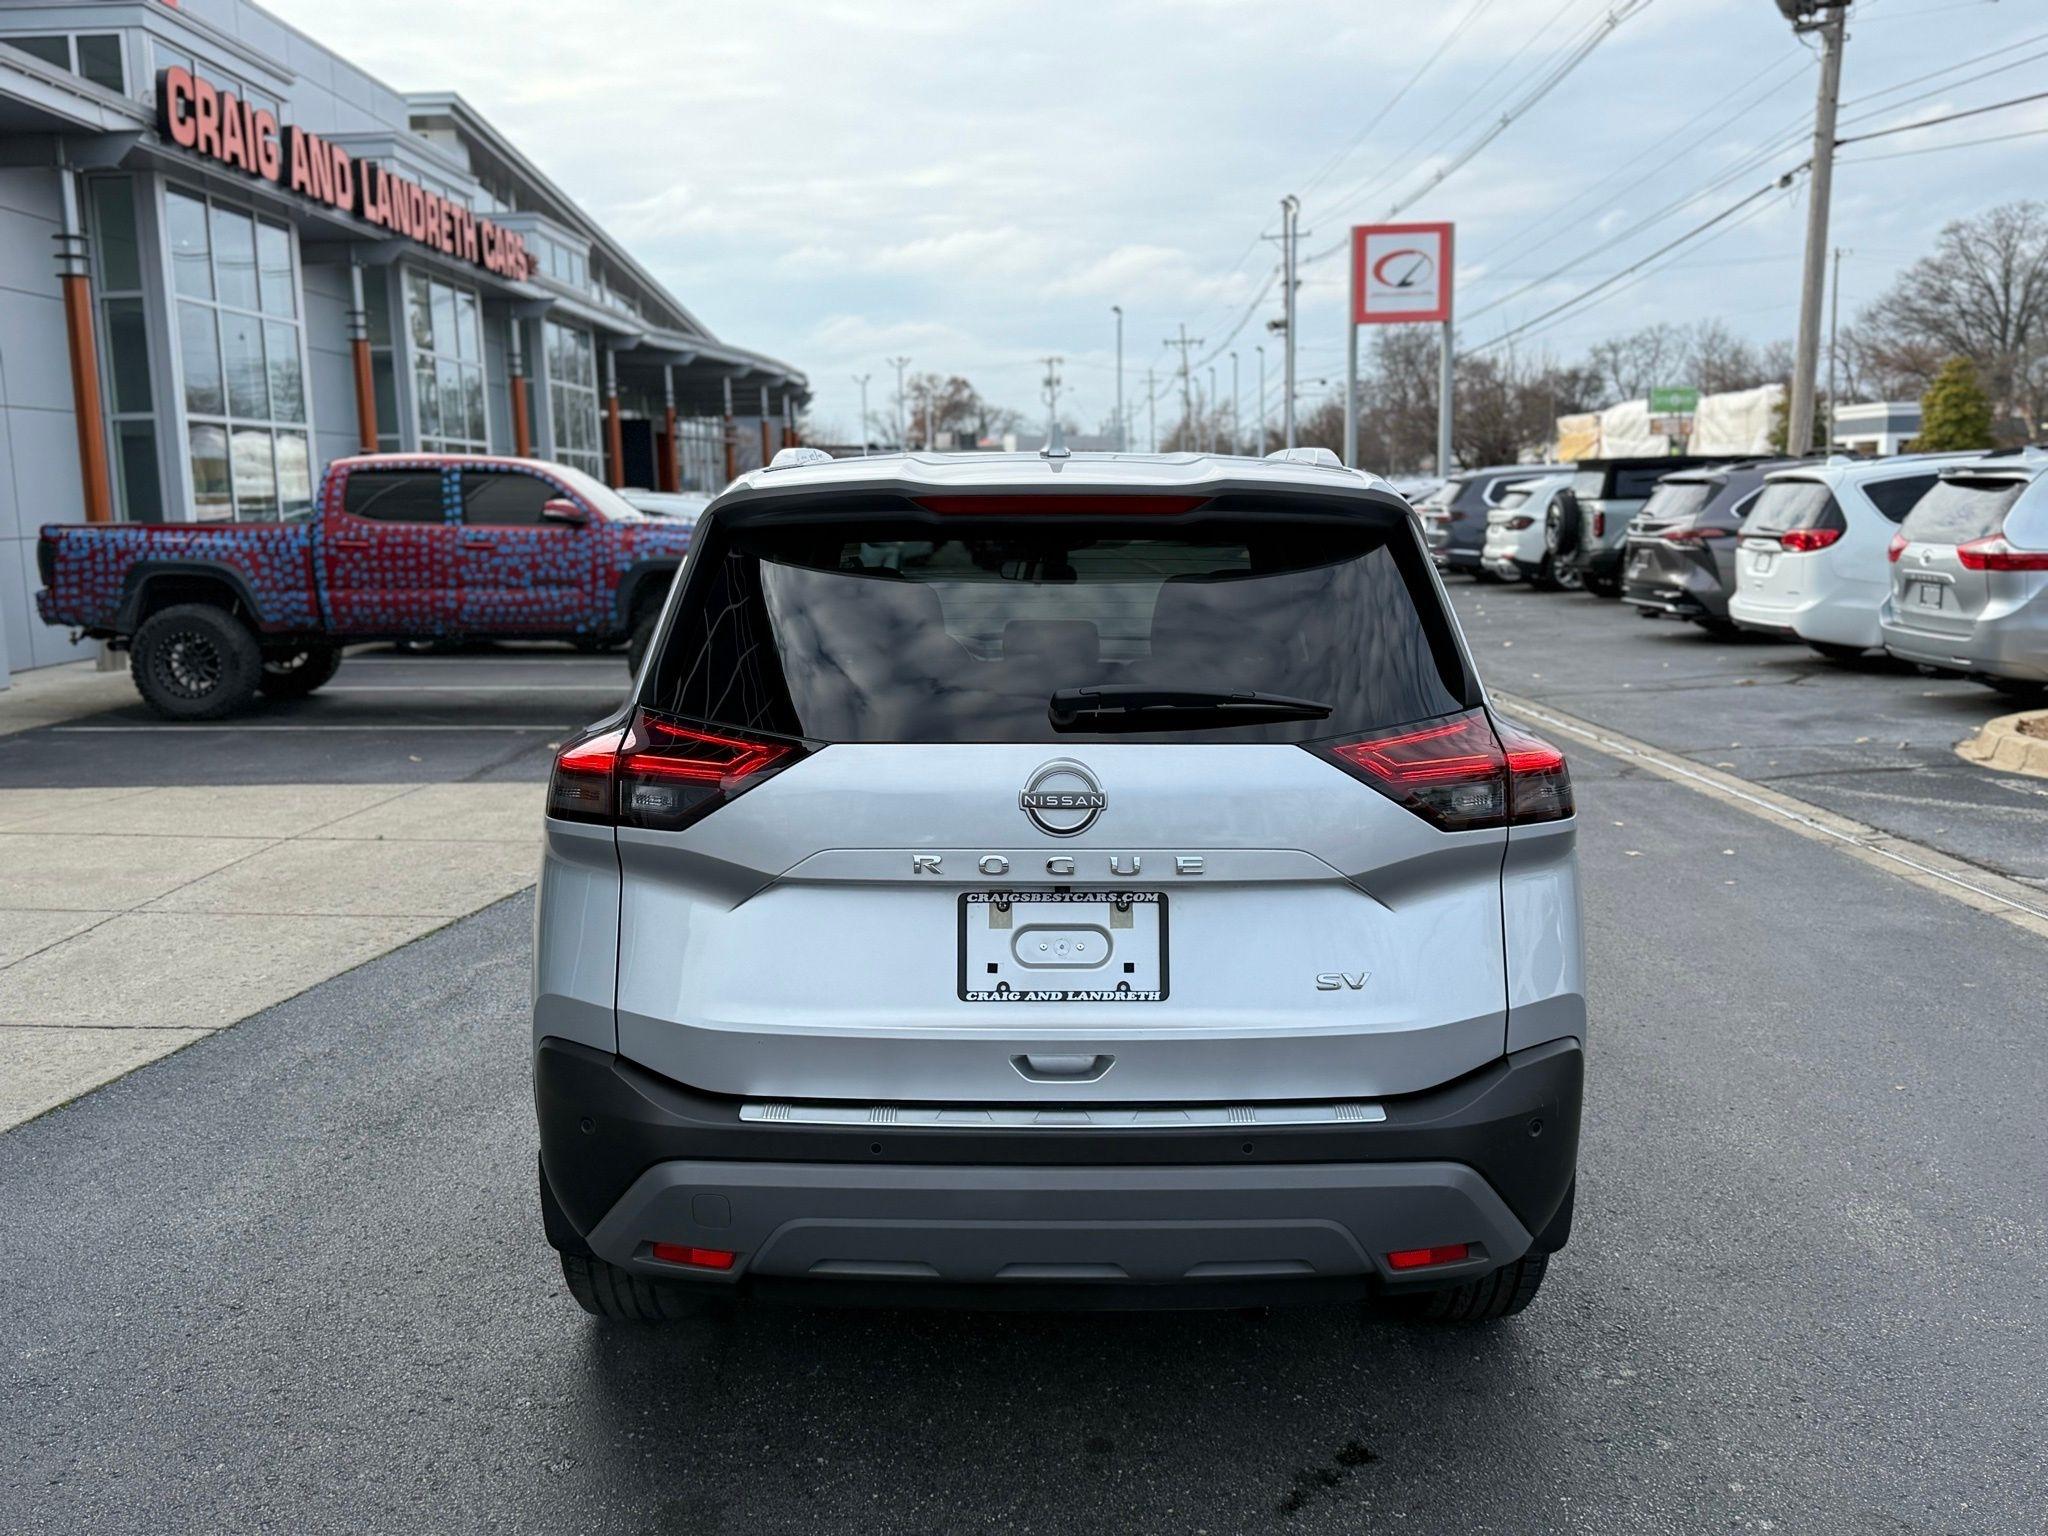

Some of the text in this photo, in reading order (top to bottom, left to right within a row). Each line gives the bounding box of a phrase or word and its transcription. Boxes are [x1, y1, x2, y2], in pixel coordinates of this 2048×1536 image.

[166, 65, 528, 283] CRAIG AND LANDRETH CARS
[1024, 796, 1103, 806] NISSAN
[912, 855, 1204, 875] ROGUE
[966, 893, 1159, 903] CRAIGSBESTCARS.COM
[1316, 972, 1372, 991] SV
[966, 991, 1161, 1001] CRAIG AND LANDRETH
